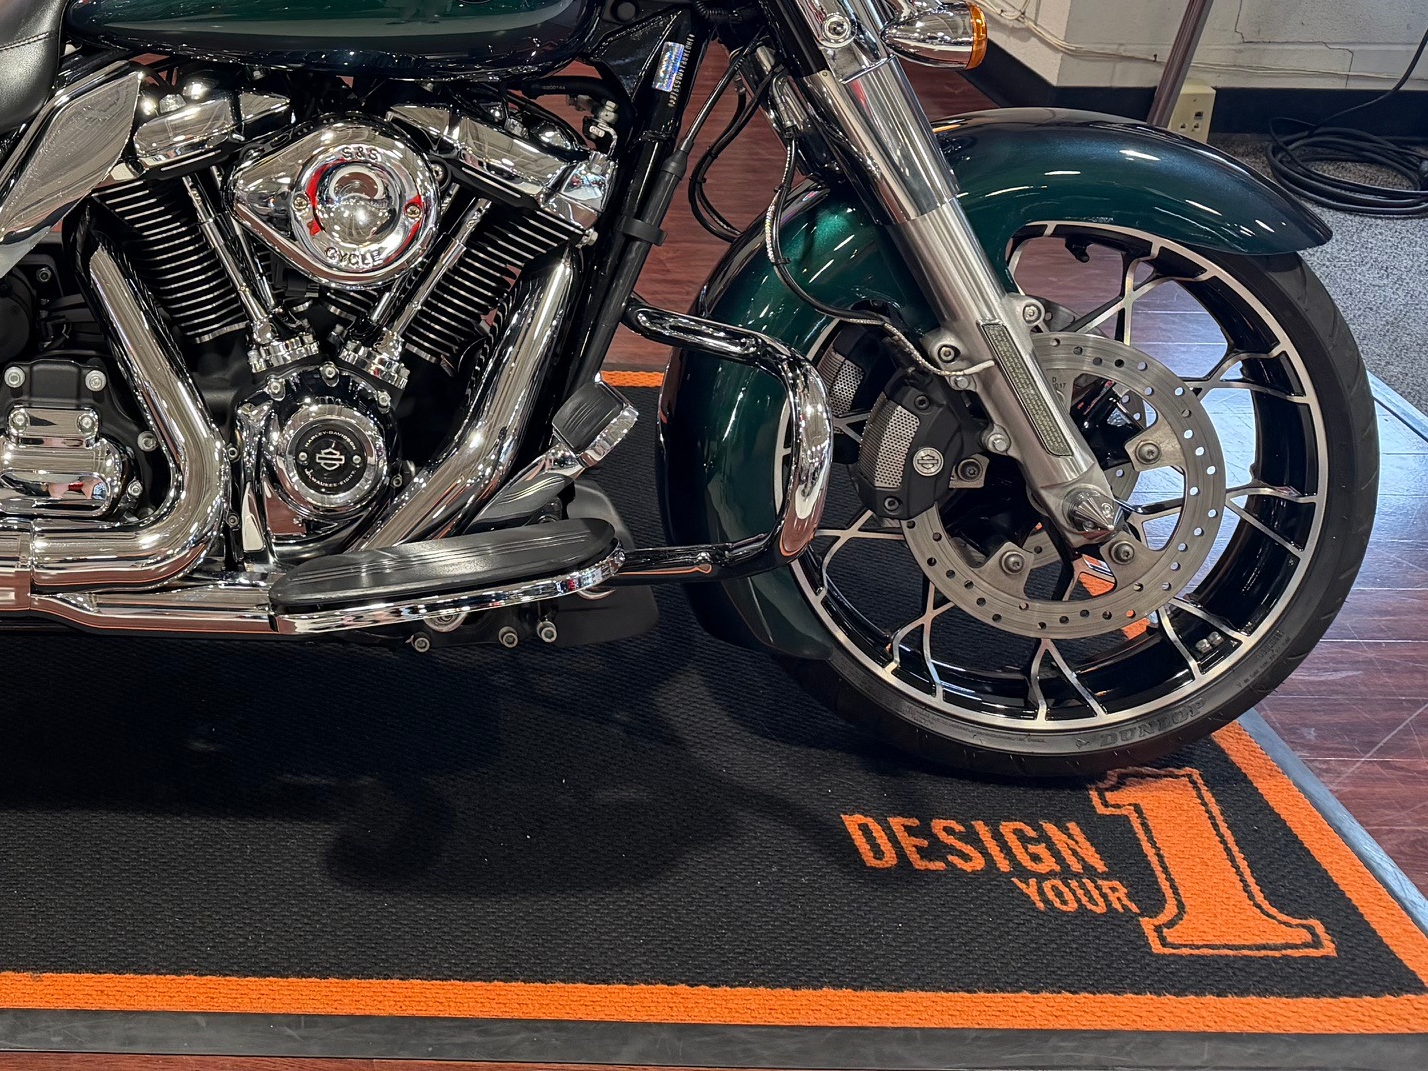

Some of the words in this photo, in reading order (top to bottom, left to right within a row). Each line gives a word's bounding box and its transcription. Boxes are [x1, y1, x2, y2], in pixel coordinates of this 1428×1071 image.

[342, 145, 379, 161] S&S
[324, 245, 385, 268] CYCLE
[304, 430, 357, 451] HARLEY-DAVIDSON
[1098, 697, 1209, 750] DUNLOP
[840, 812, 1108, 873] DESIGN
[1010, 877, 1140, 914] YOUR
